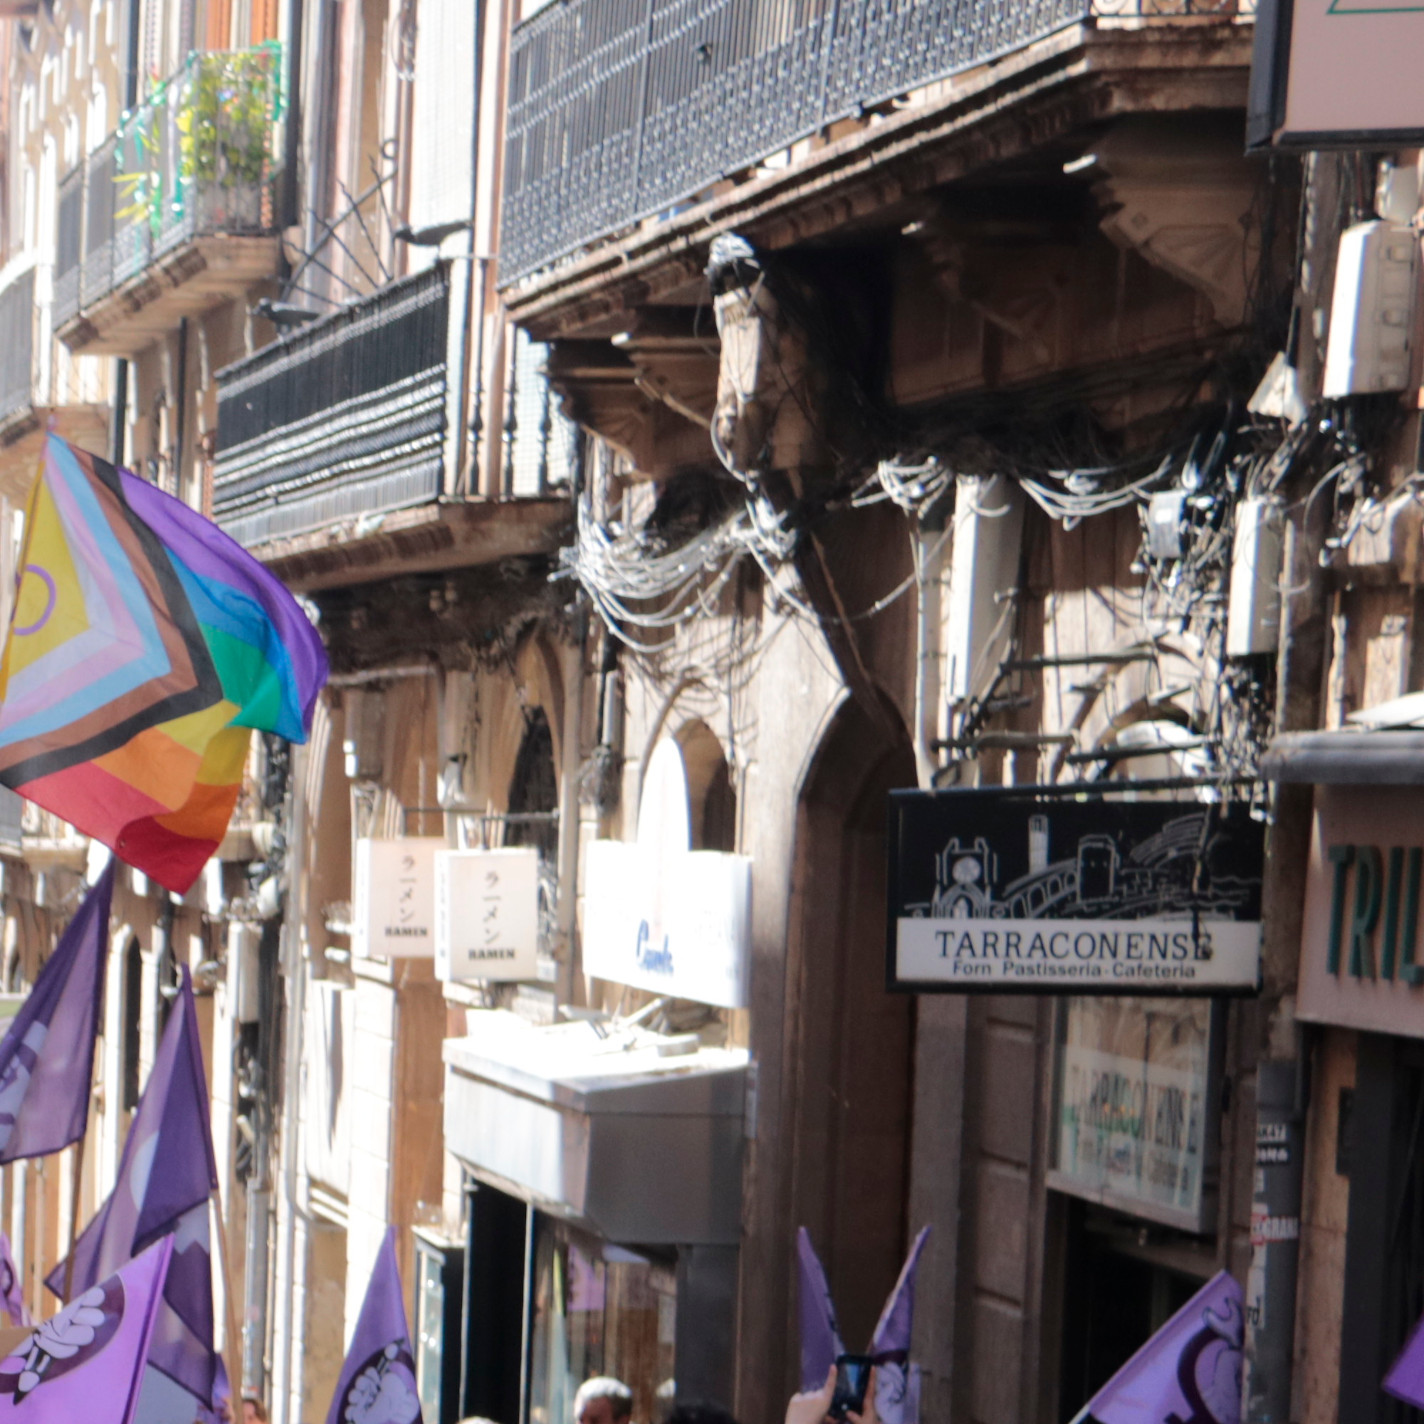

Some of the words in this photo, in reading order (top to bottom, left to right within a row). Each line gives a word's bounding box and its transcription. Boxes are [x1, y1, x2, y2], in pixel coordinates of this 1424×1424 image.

[384, 926, 428, 938] RAMEN
[935, 930, 1213, 962] TARRACONENSE
[468, 948, 516, 961] RAMEN
[953, 961, 992, 976] Forn
